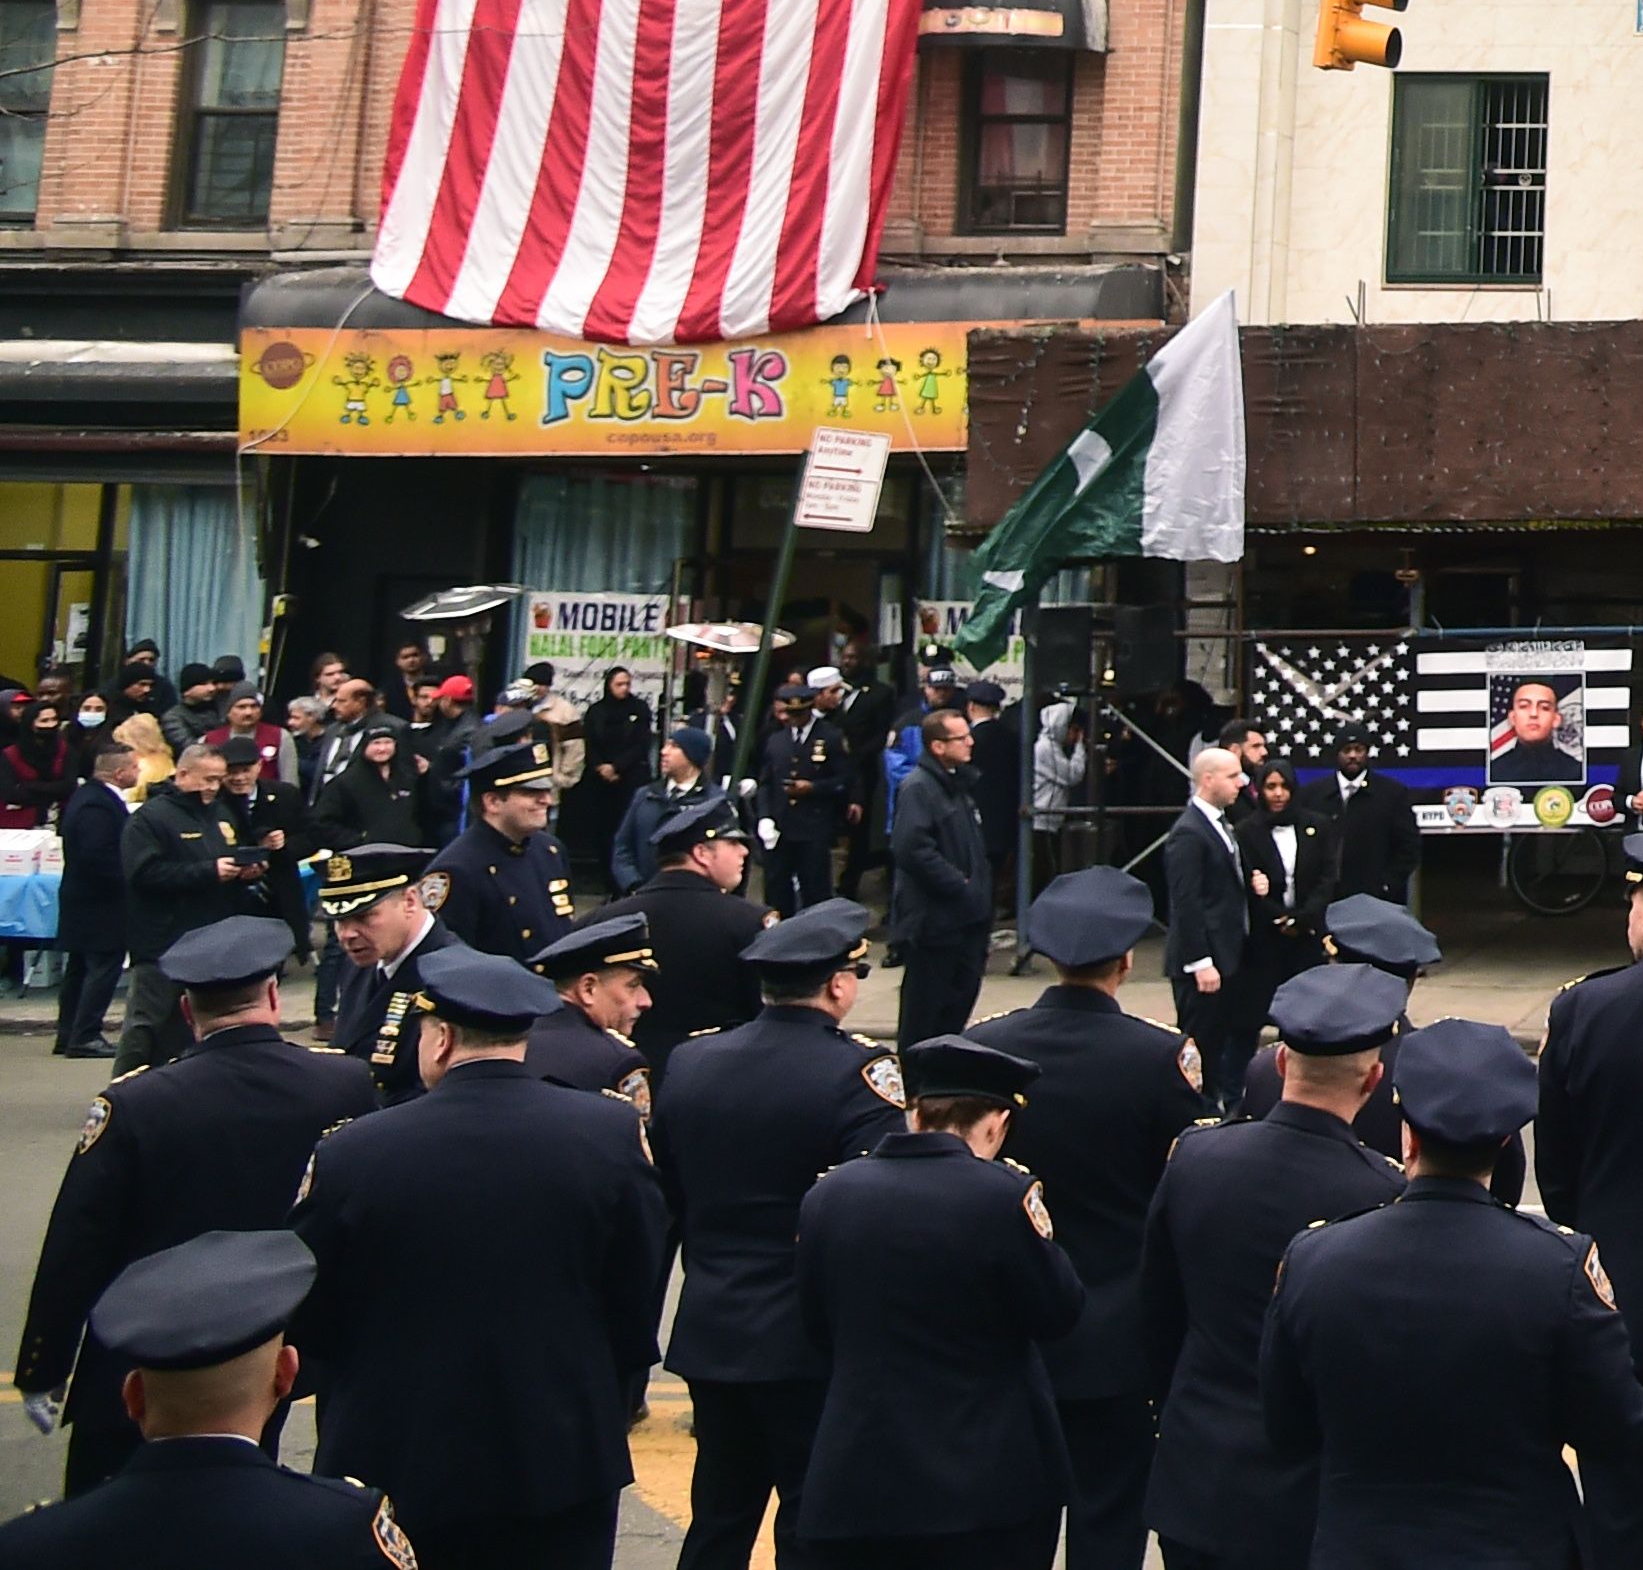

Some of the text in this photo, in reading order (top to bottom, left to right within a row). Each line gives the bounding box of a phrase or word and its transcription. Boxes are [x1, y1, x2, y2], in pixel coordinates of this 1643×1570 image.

[542, 346, 787, 426] PRE-K
[606, 431, 717, 446] copousa.org
[835, 436, 872, 447] PARKING
[558, 602, 660, 632] MOBILE
[1421, 809, 1445, 822] NYPD
